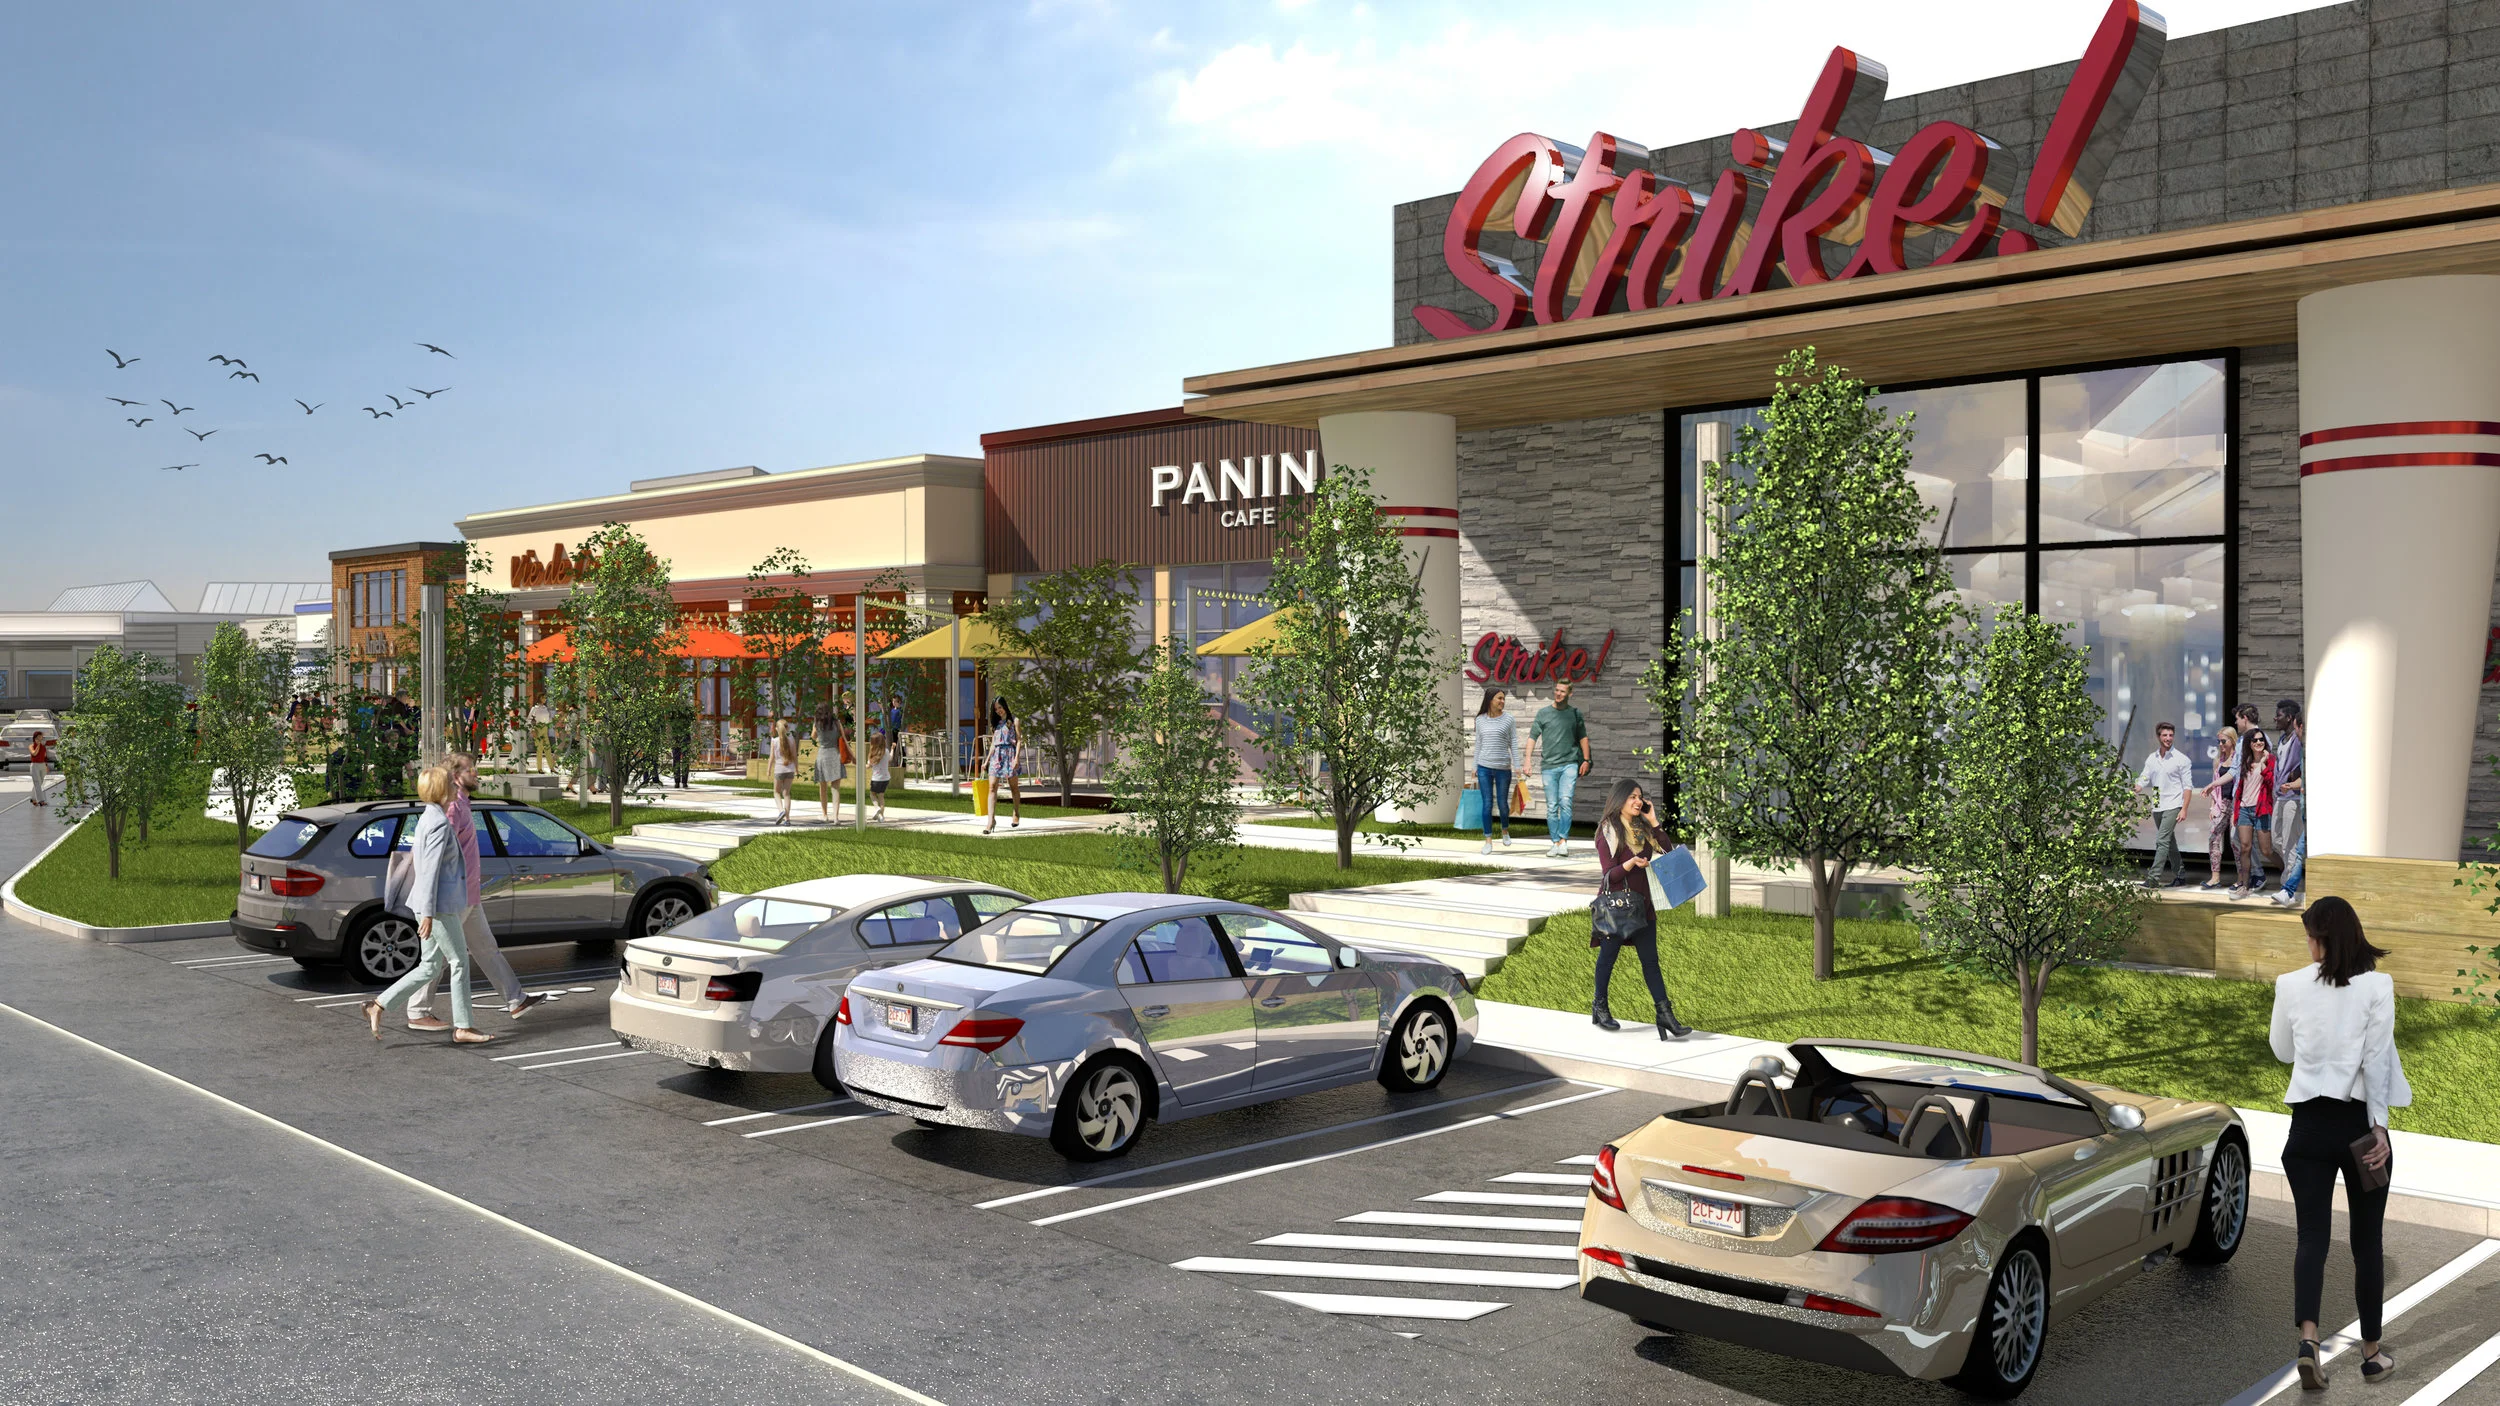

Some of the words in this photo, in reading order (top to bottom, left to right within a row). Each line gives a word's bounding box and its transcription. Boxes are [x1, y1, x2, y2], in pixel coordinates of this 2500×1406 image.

[1413, 0, 2166, 340] Strike!
[1220, 507, 1276, 528] CAFE
[1464, 627, 1615, 684] Strike!
